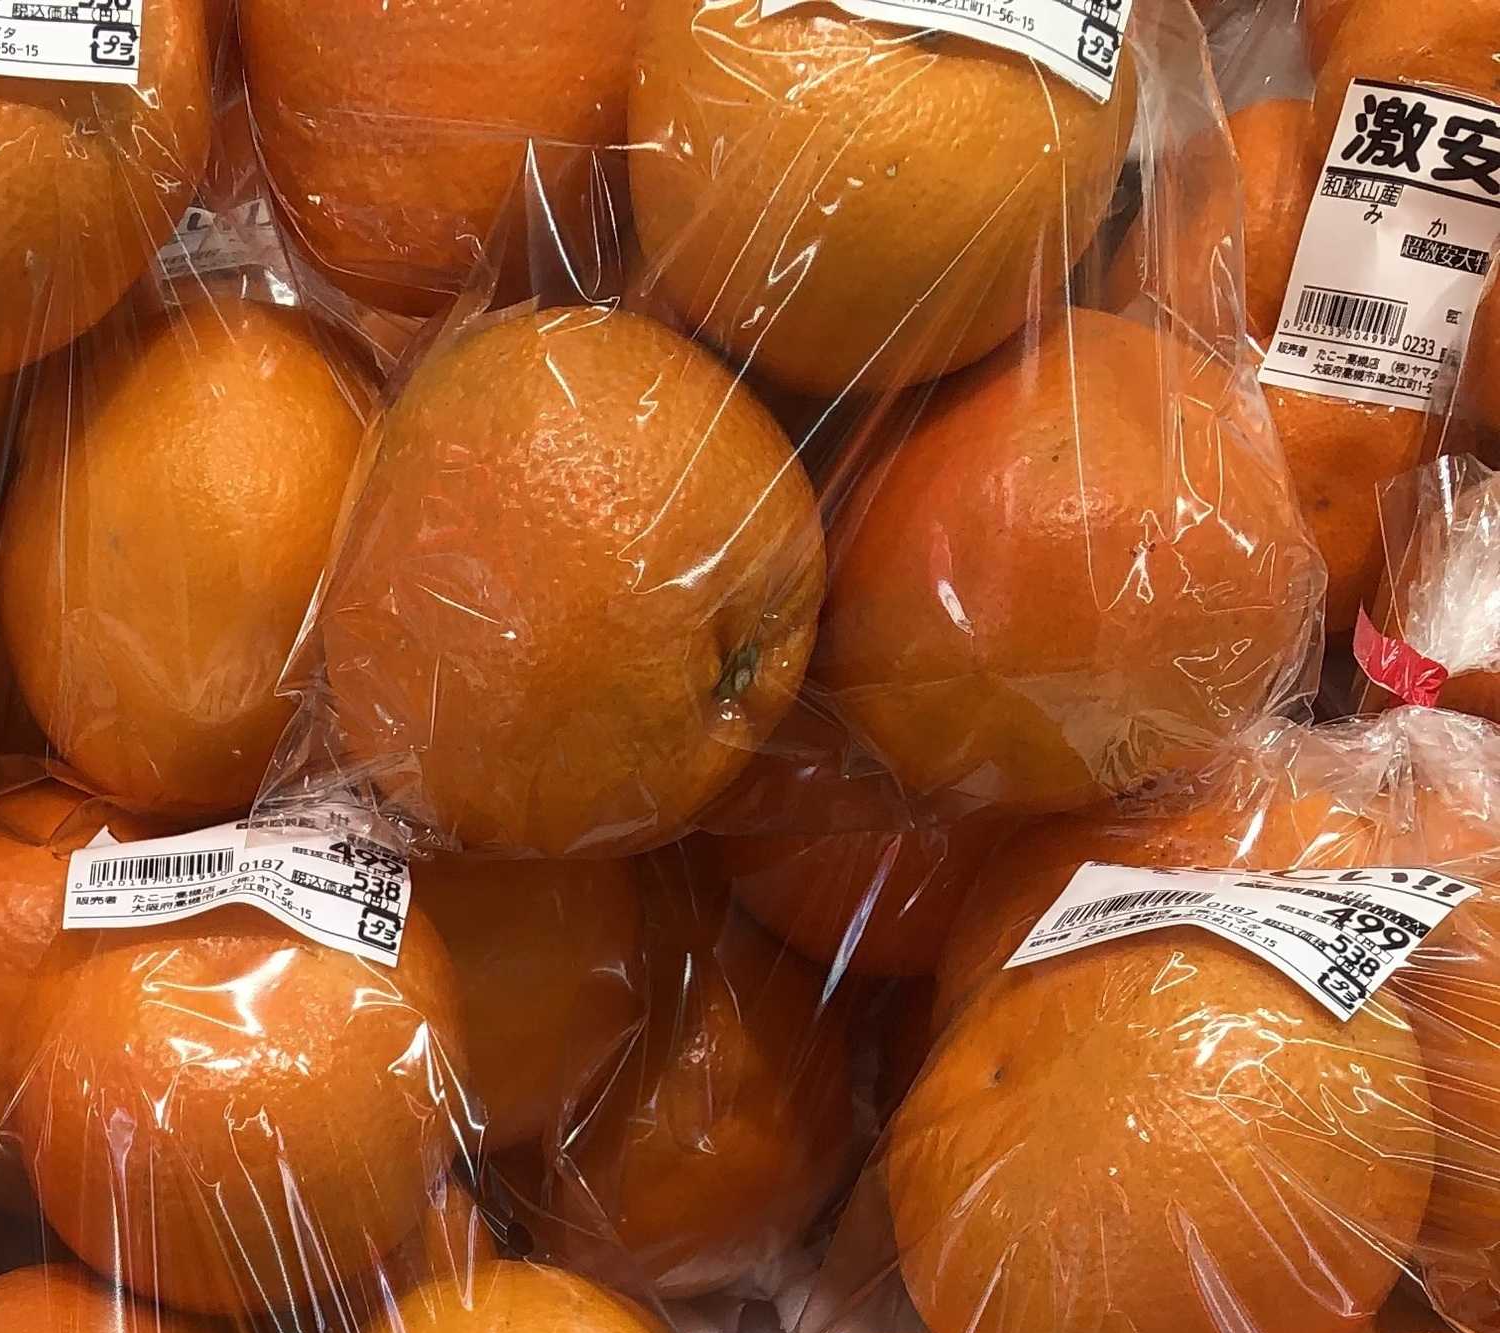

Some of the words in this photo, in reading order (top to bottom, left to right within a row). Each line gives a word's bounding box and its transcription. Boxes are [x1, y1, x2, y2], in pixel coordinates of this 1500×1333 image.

[1341, 94, 1500, 194] 激安
[1322, 173, 1403, 207] 和歌山産
[1277, 342, 1308, 357] 販売者
[1403, 335, 1435, 355] 0233
[239, 859, 284, 872] 0187
[329, 842, 403, 875] 499
[352, 872, 401, 900] 538
[1207, 902, 1258, 915] 0187
[1322, 907, 1410, 951] 499
[1329, 935, 1380, 977] 538
